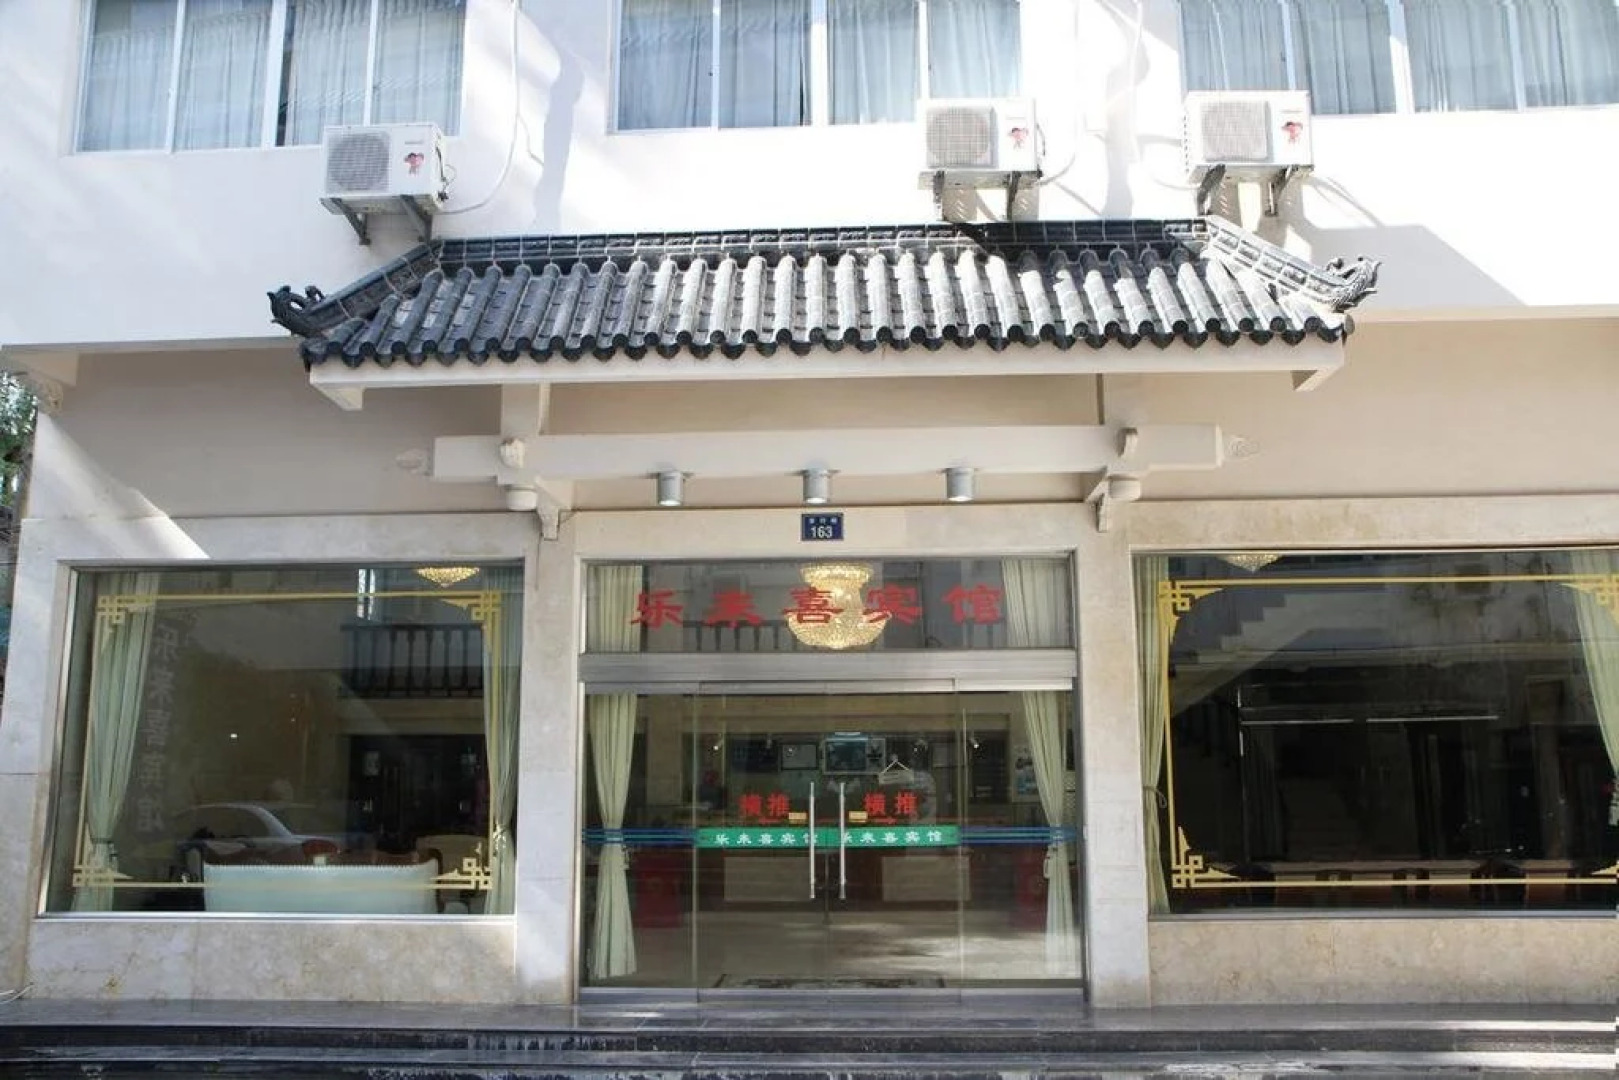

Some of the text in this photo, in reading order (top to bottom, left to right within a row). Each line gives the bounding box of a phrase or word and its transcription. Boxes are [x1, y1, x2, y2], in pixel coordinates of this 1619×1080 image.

[811, 525, 833, 538] 163
[631, 584, 1003, 629] 乐来喜宾馆
